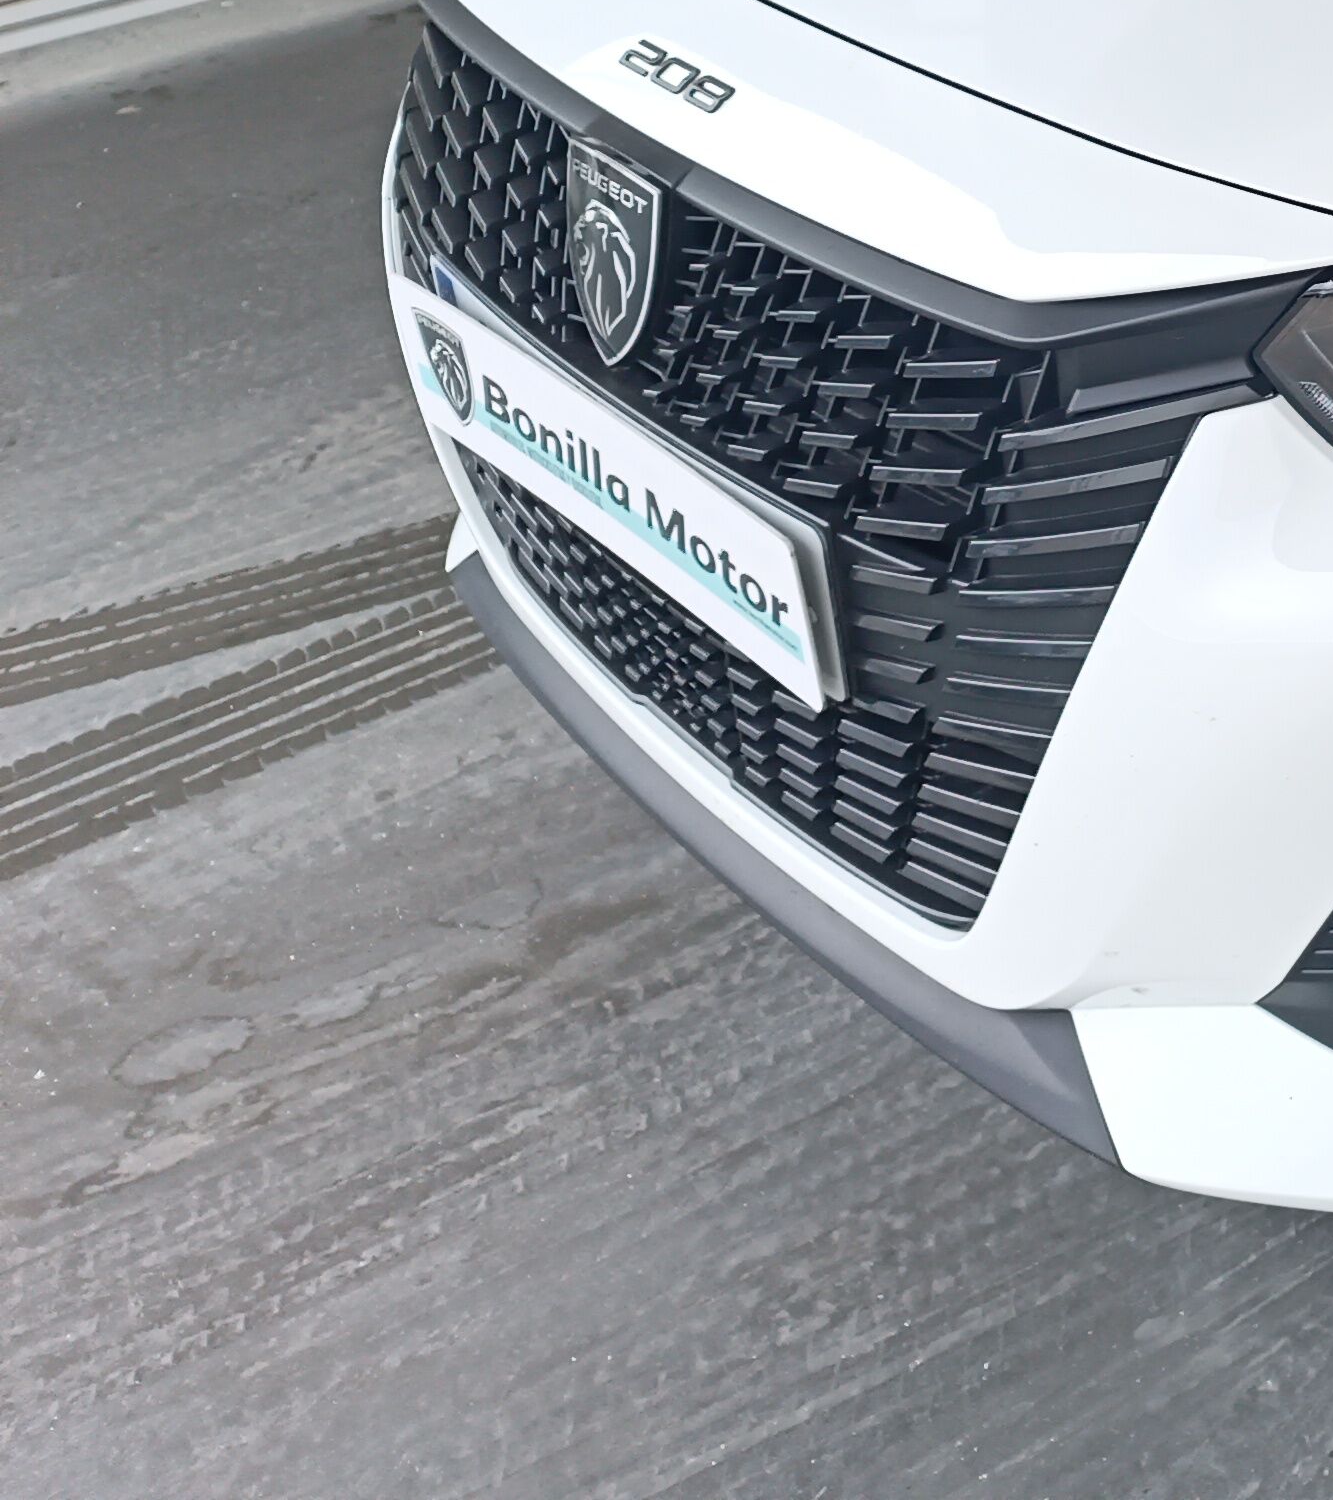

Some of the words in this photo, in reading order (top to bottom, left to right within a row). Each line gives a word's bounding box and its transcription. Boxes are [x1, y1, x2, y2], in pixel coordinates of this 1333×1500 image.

[618, 39, 737, 114] 208
[572, 158, 649, 215] PEUGEOT
[482, 374, 631, 513] Bonilla
[645, 487, 789, 627] Motor
